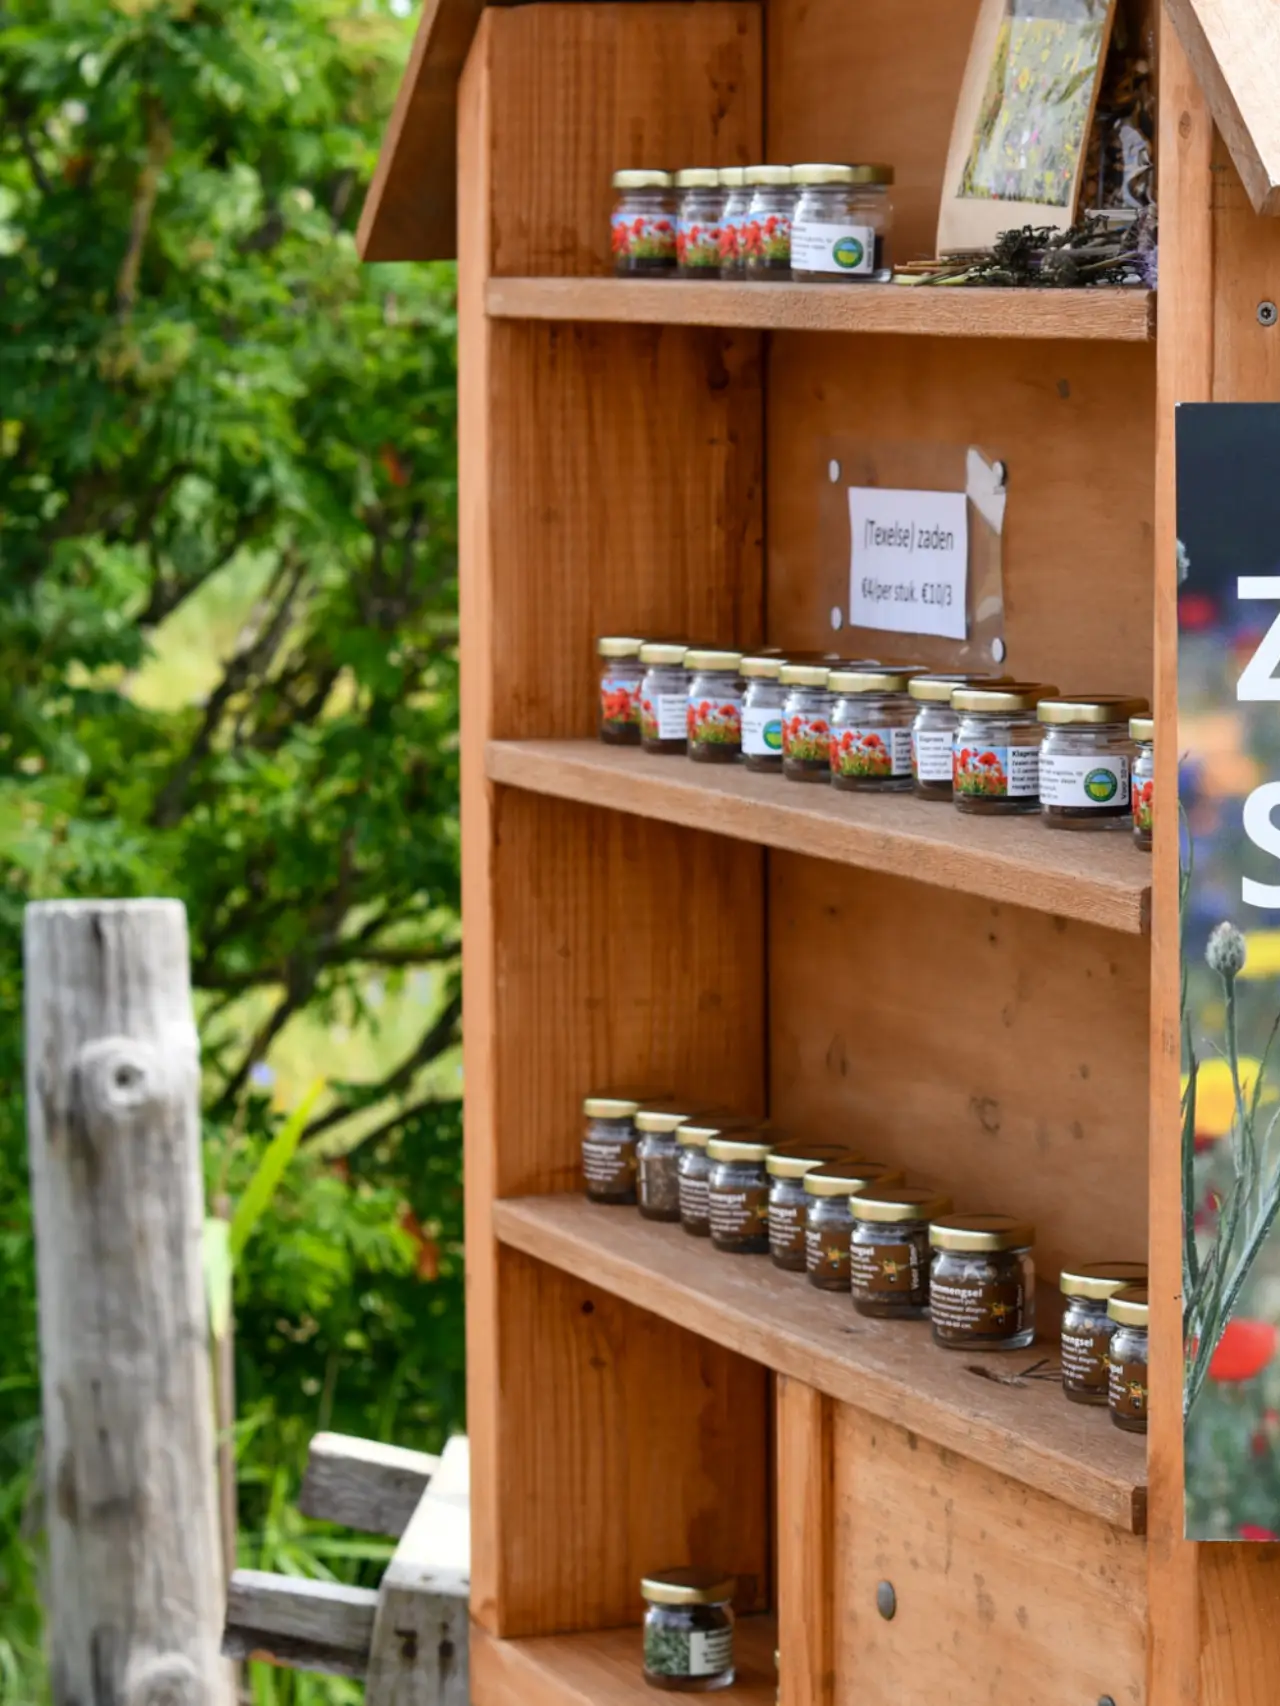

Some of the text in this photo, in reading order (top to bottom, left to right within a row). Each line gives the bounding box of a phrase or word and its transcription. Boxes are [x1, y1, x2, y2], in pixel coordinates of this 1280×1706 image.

[864, 518, 954, 554] (Texelse) zaden
[894, 580, 918, 602] stuk.
[921, 583, 953, 608] €10/3
